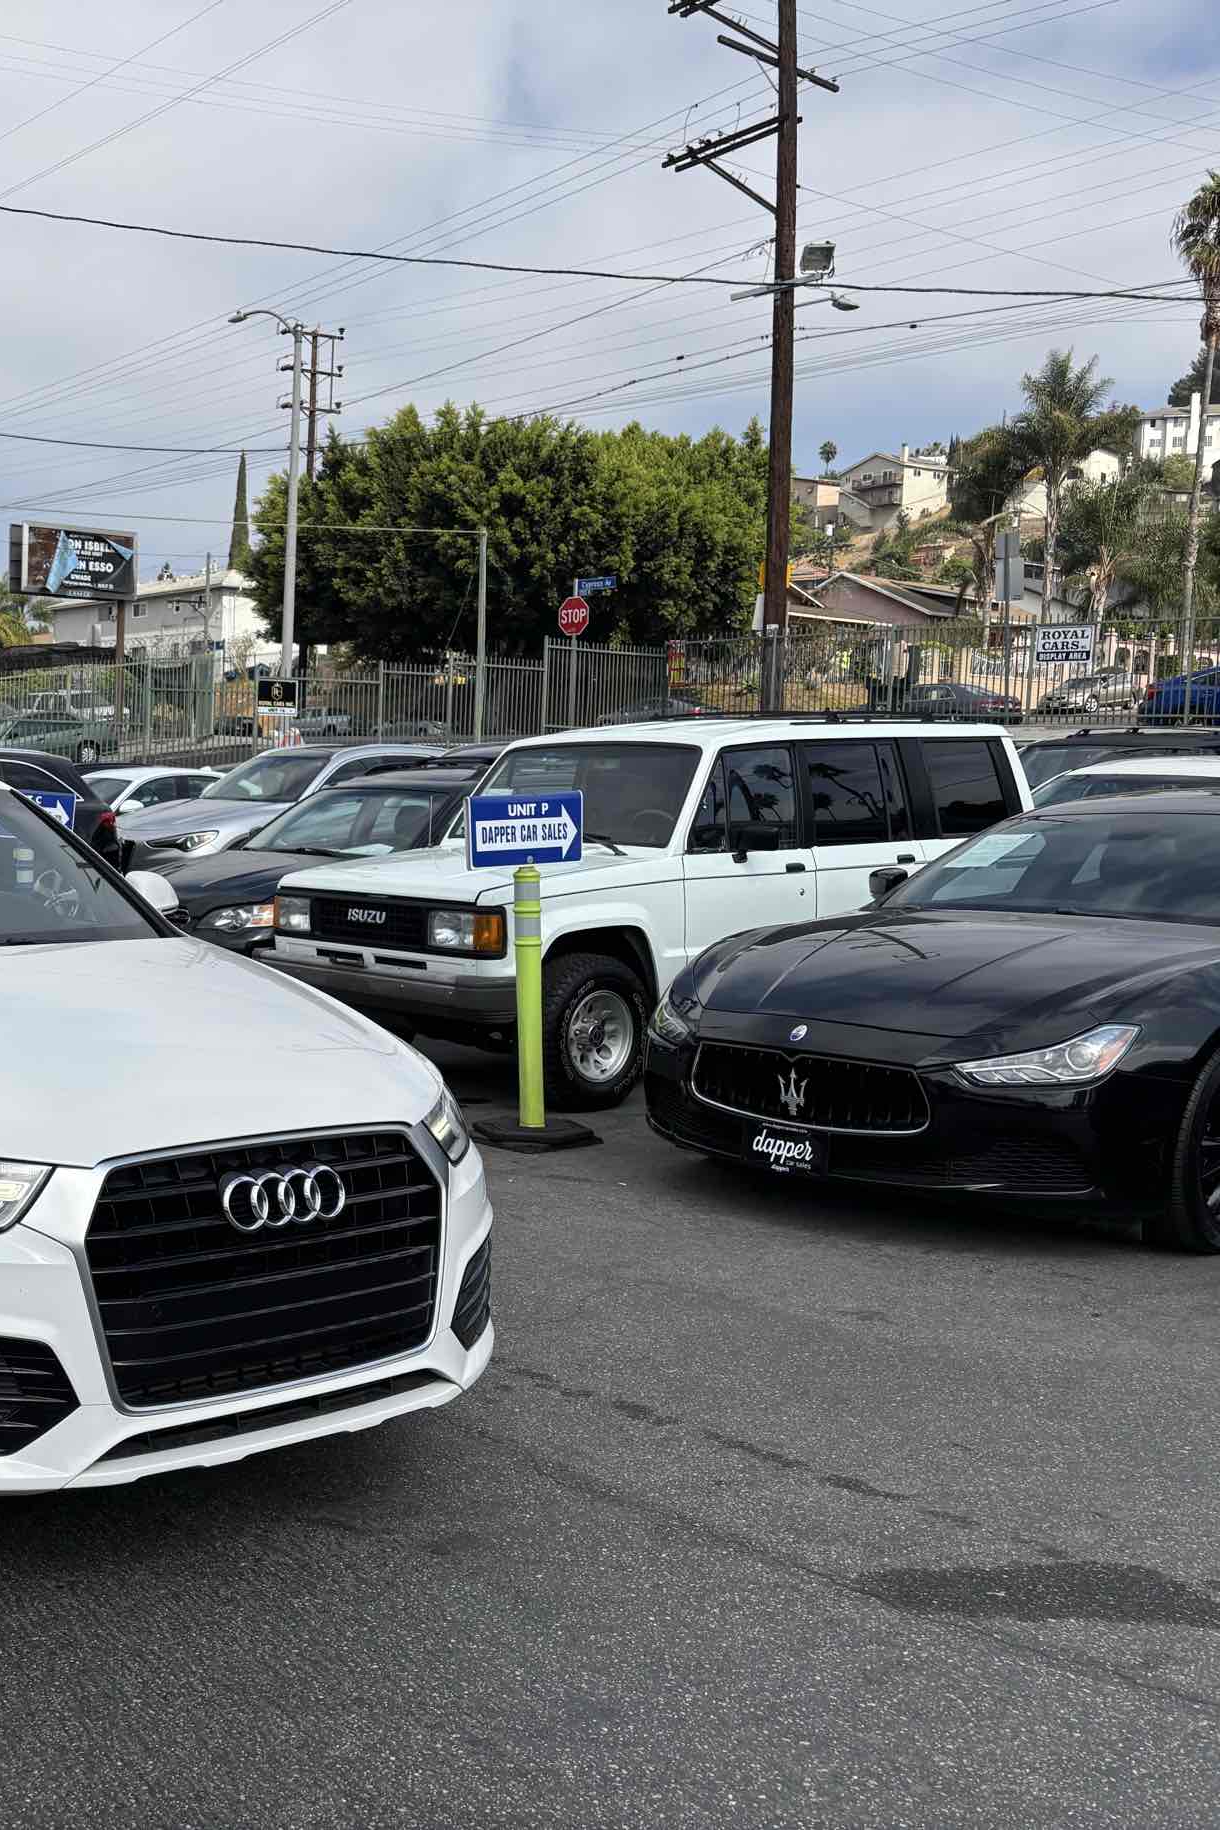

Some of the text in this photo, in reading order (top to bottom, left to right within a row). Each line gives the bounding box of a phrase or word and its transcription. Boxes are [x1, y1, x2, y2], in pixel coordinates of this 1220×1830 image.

[88, 561, 114, 573] ESSO
[561, 609, 586, 624] STOP
[1042, 629, 1089, 640] ROYAL
[1042, 641, 1079, 650] CARS
[1039, 652, 1087, 660] DISPLAY AREA
[508, 802, 549, 817] UNIT P
[482, 822, 568, 844] DAPPER CAR SALES
[347, 908, 386, 924] ISUZU
[752, 1129, 813, 1164] dapper
